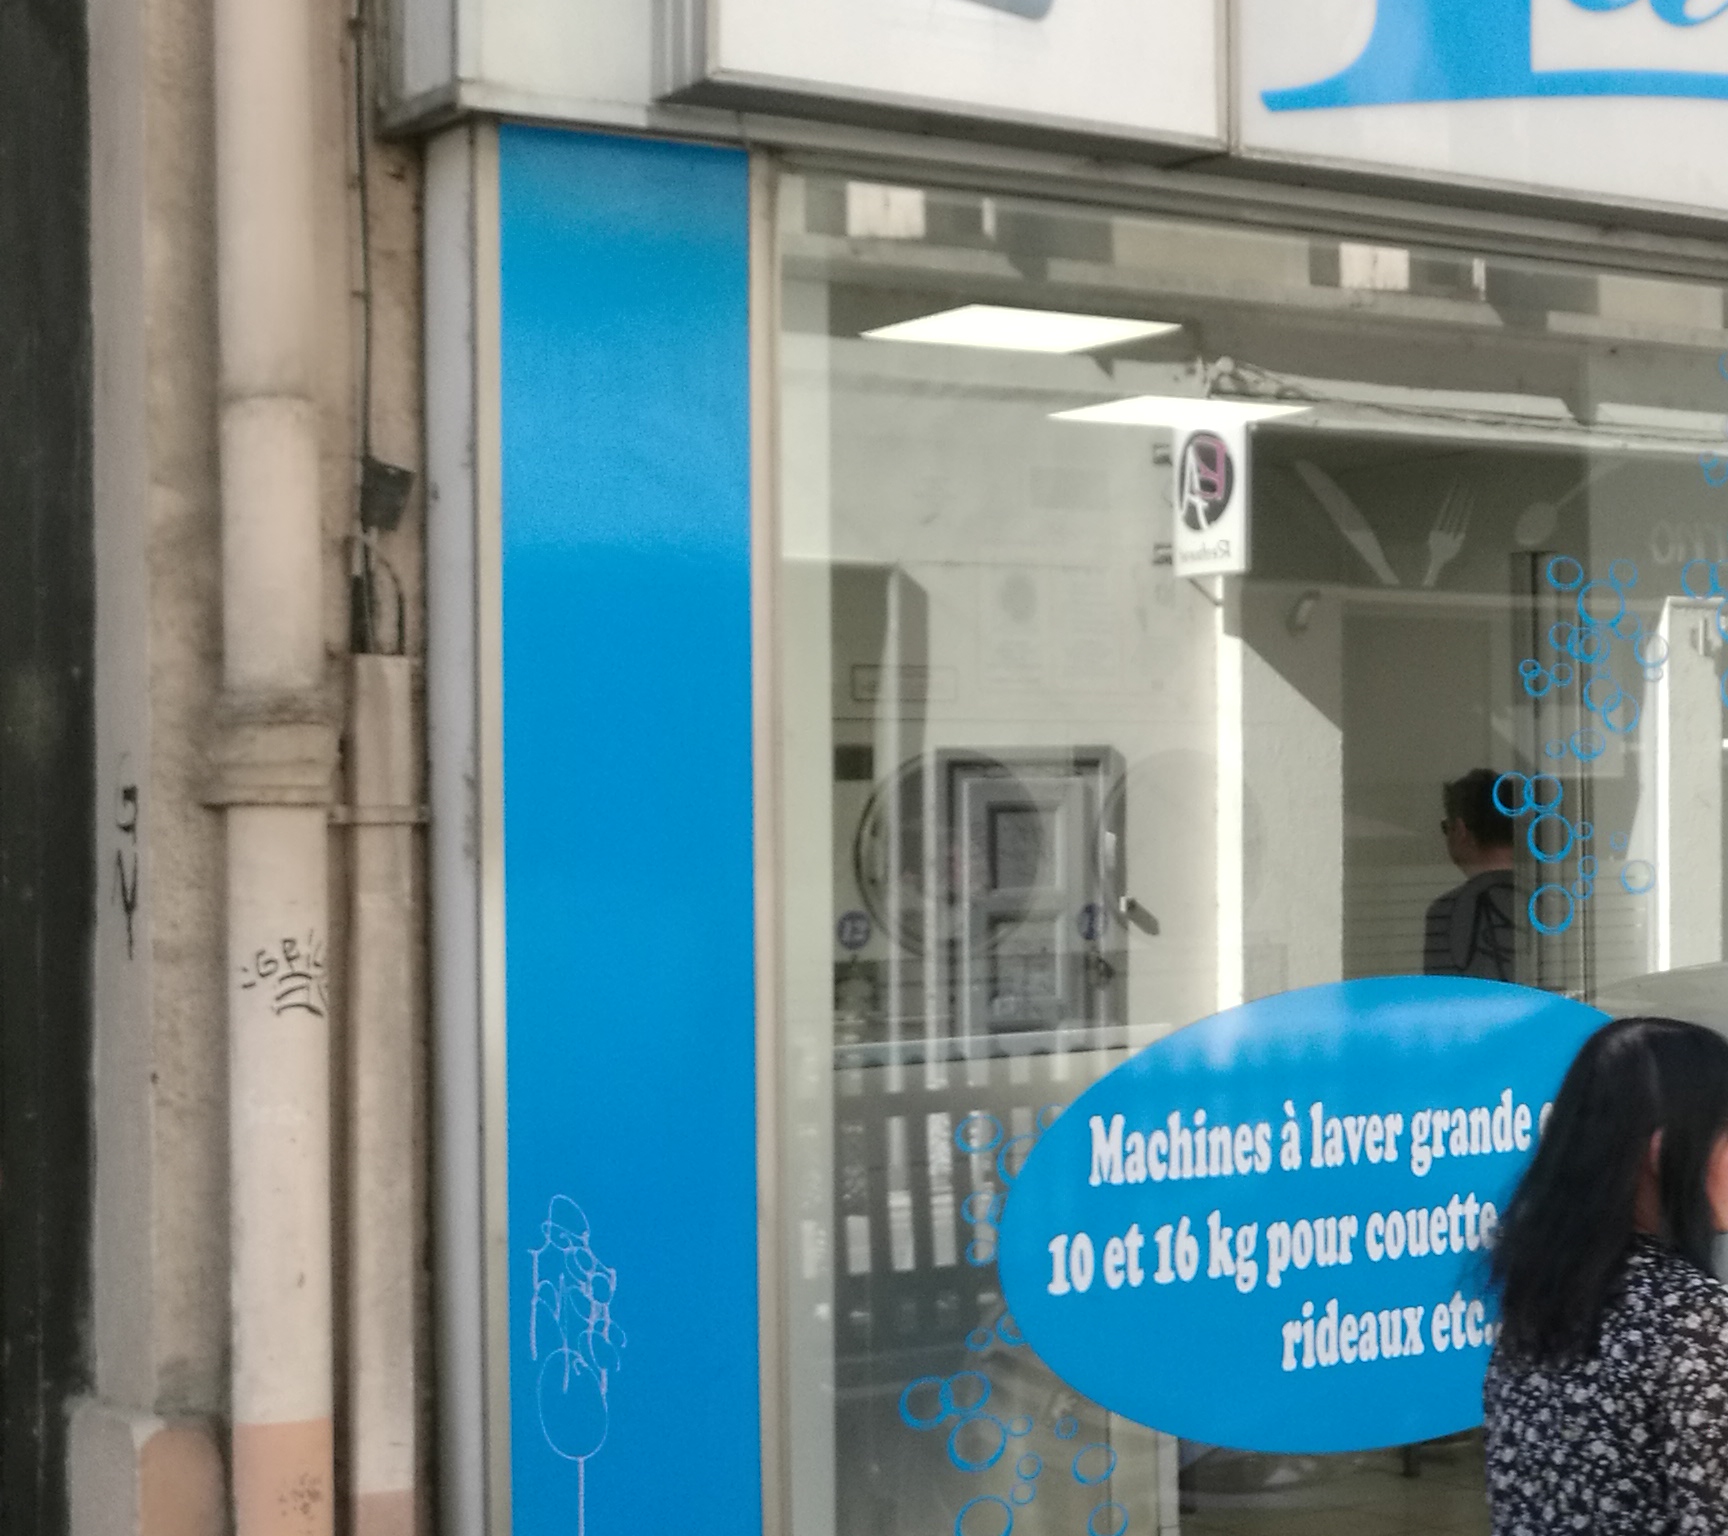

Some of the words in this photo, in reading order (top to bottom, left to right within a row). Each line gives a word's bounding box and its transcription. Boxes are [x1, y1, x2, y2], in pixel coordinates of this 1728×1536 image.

[1087, 1108, 1272, 1187] Machines
[1280, 1099, 1302, 1172] à
[1309, 1100, 1404, 1168] laver
[1410, 1088, 1532, 1177] grande
[1047, 1232, 1095, 1296] 10
[1103, 1222, 1146, 1290] et
[1152, 1215, 1199, 1285] 16
[1206, 1208, 1257, 1294] kg
[1265, 1210, 1360, 1289] pour
[1365, 1191, 1504, 1262] couette
[1280, 1298, 1424, 1372] rideaux
